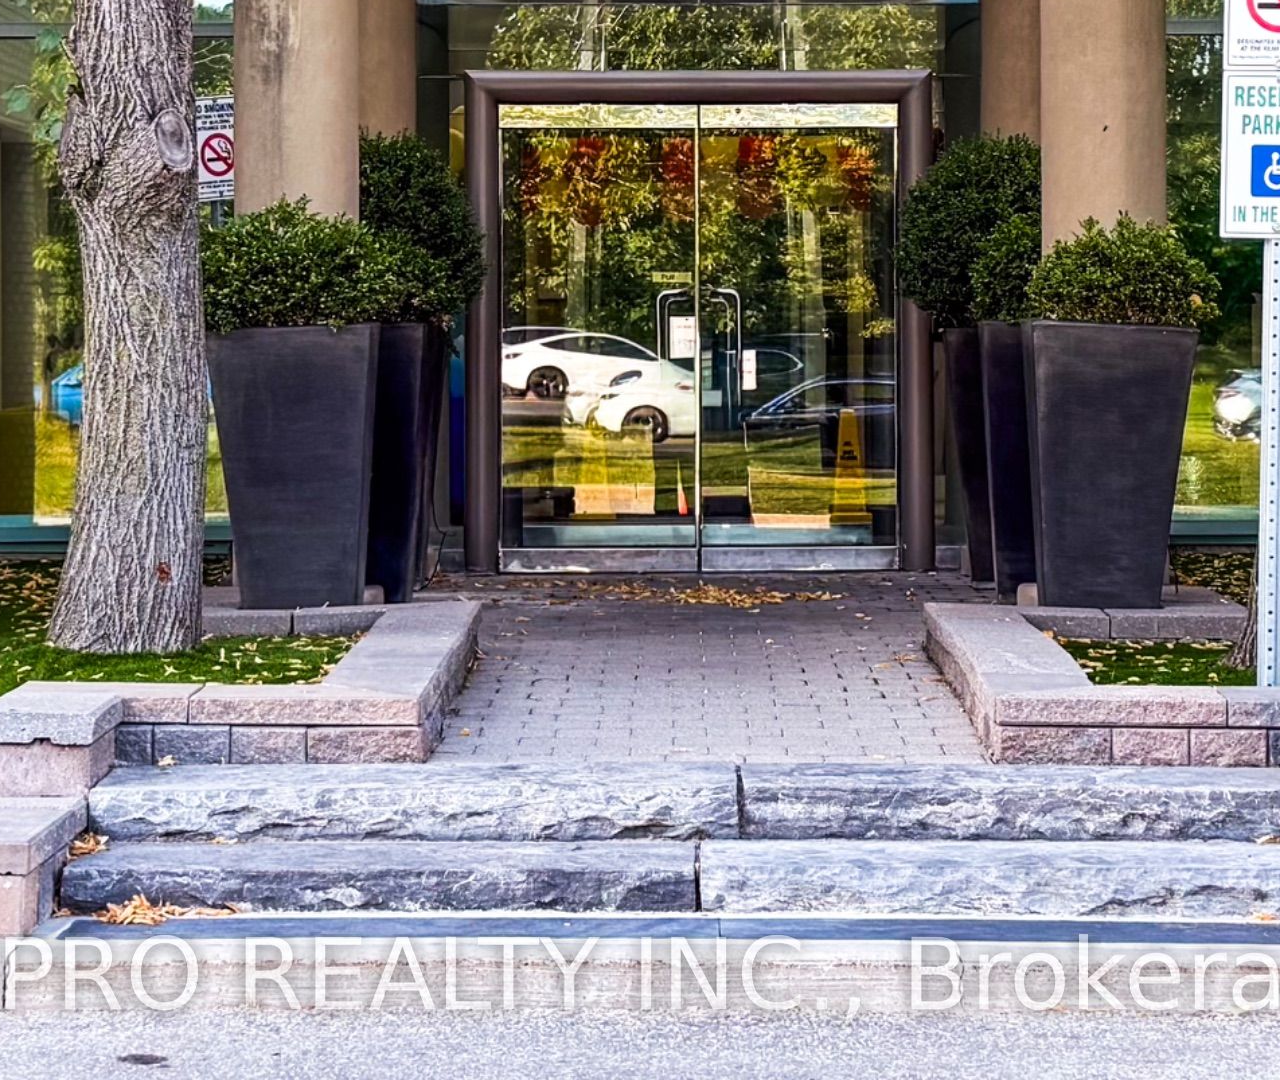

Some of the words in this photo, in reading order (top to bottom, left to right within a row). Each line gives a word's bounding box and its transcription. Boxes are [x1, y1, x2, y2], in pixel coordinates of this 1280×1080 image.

[195, 104, 202, 114] O
[1232, 205, 1246, 222] IN
[1251, 206, 1278, 223] THE
